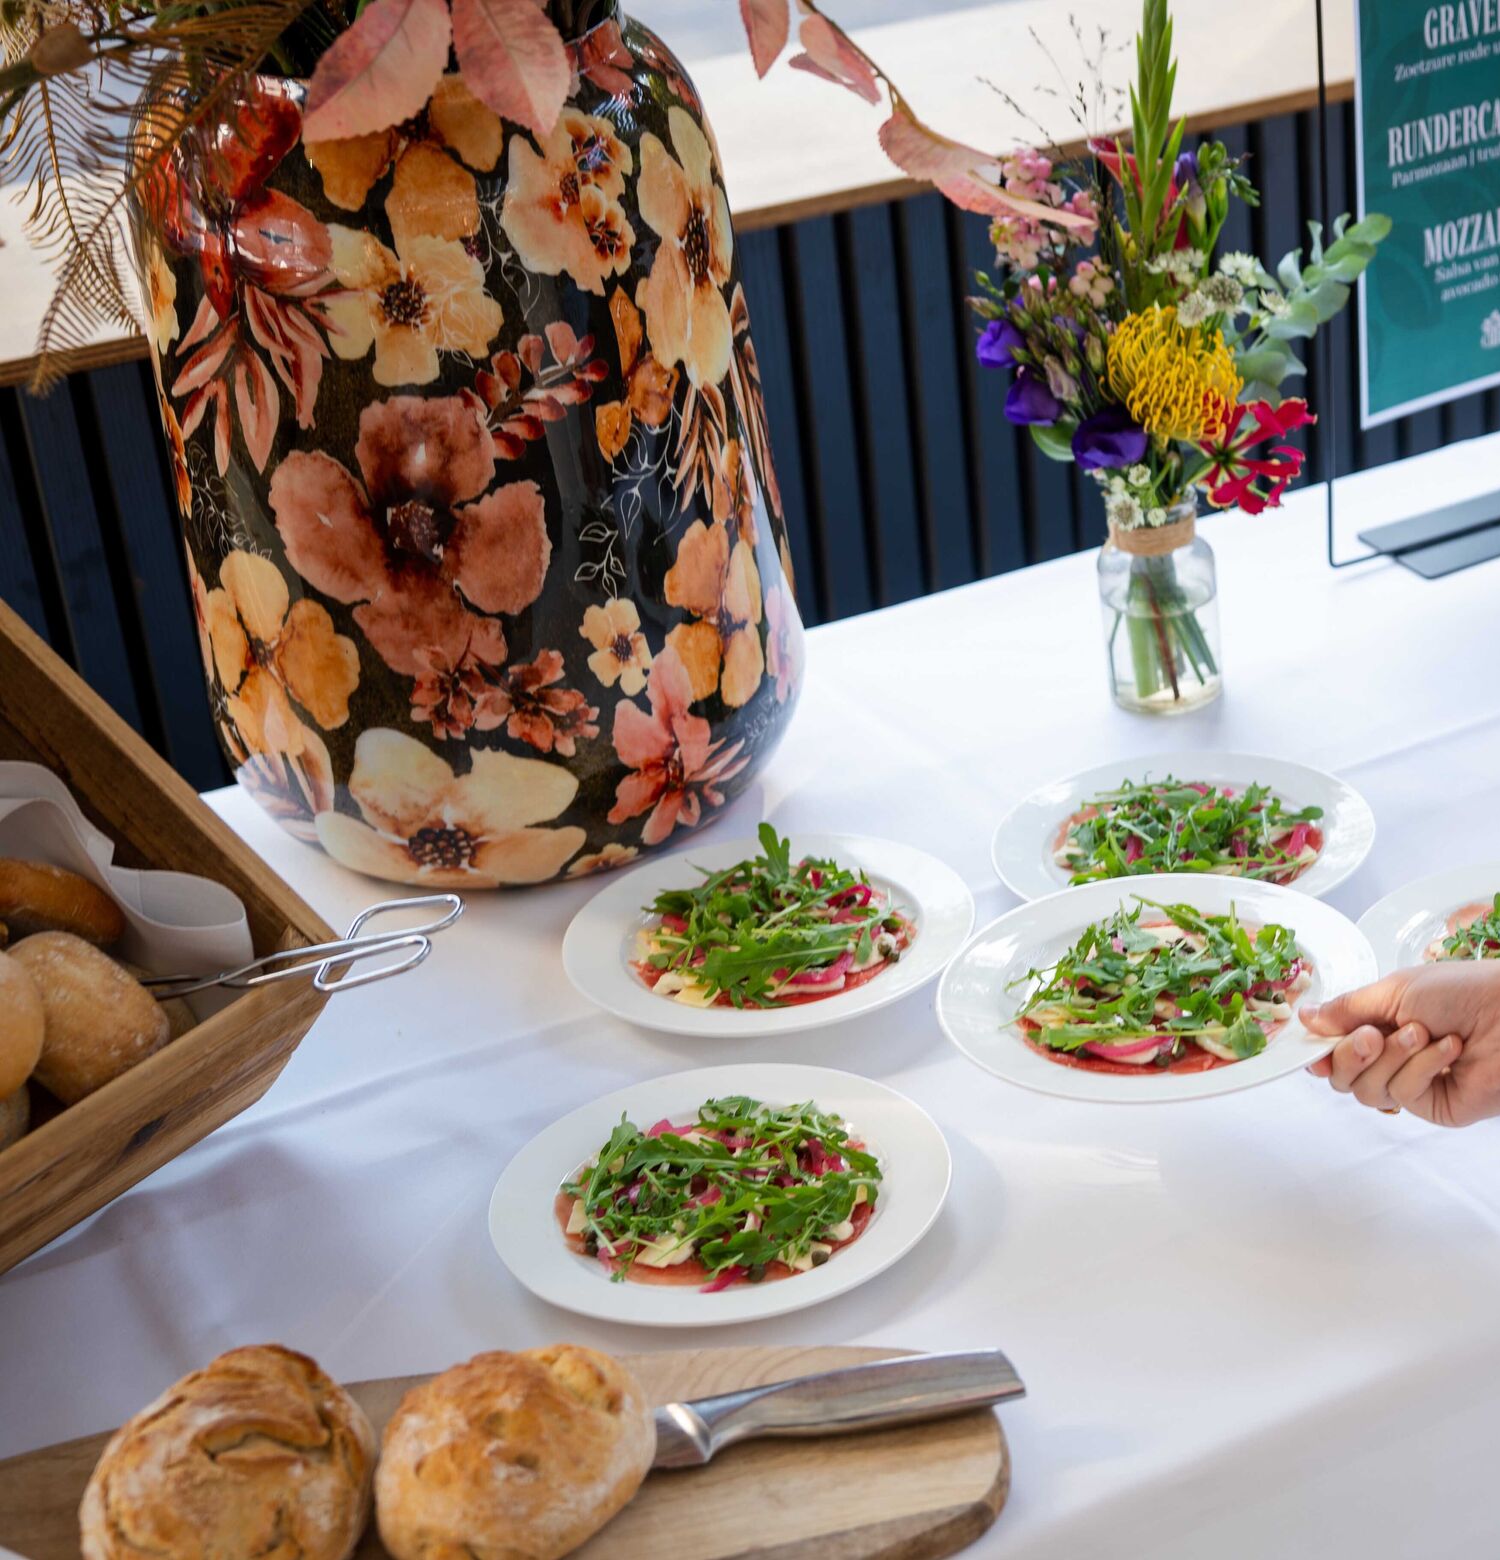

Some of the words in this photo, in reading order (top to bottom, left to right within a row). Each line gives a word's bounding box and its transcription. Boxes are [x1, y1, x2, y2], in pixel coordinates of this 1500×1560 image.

[1394, 52, 1457, 82] Zoetzure
[1458, 42, 1490, 63] rode
[1391, 154, 1468, 189] Parmezaan
[1435, 262, 1472, 284] Salsa
[1473, 253, 1499, 272] van
[1440, 272, 1499, 302] avocado
